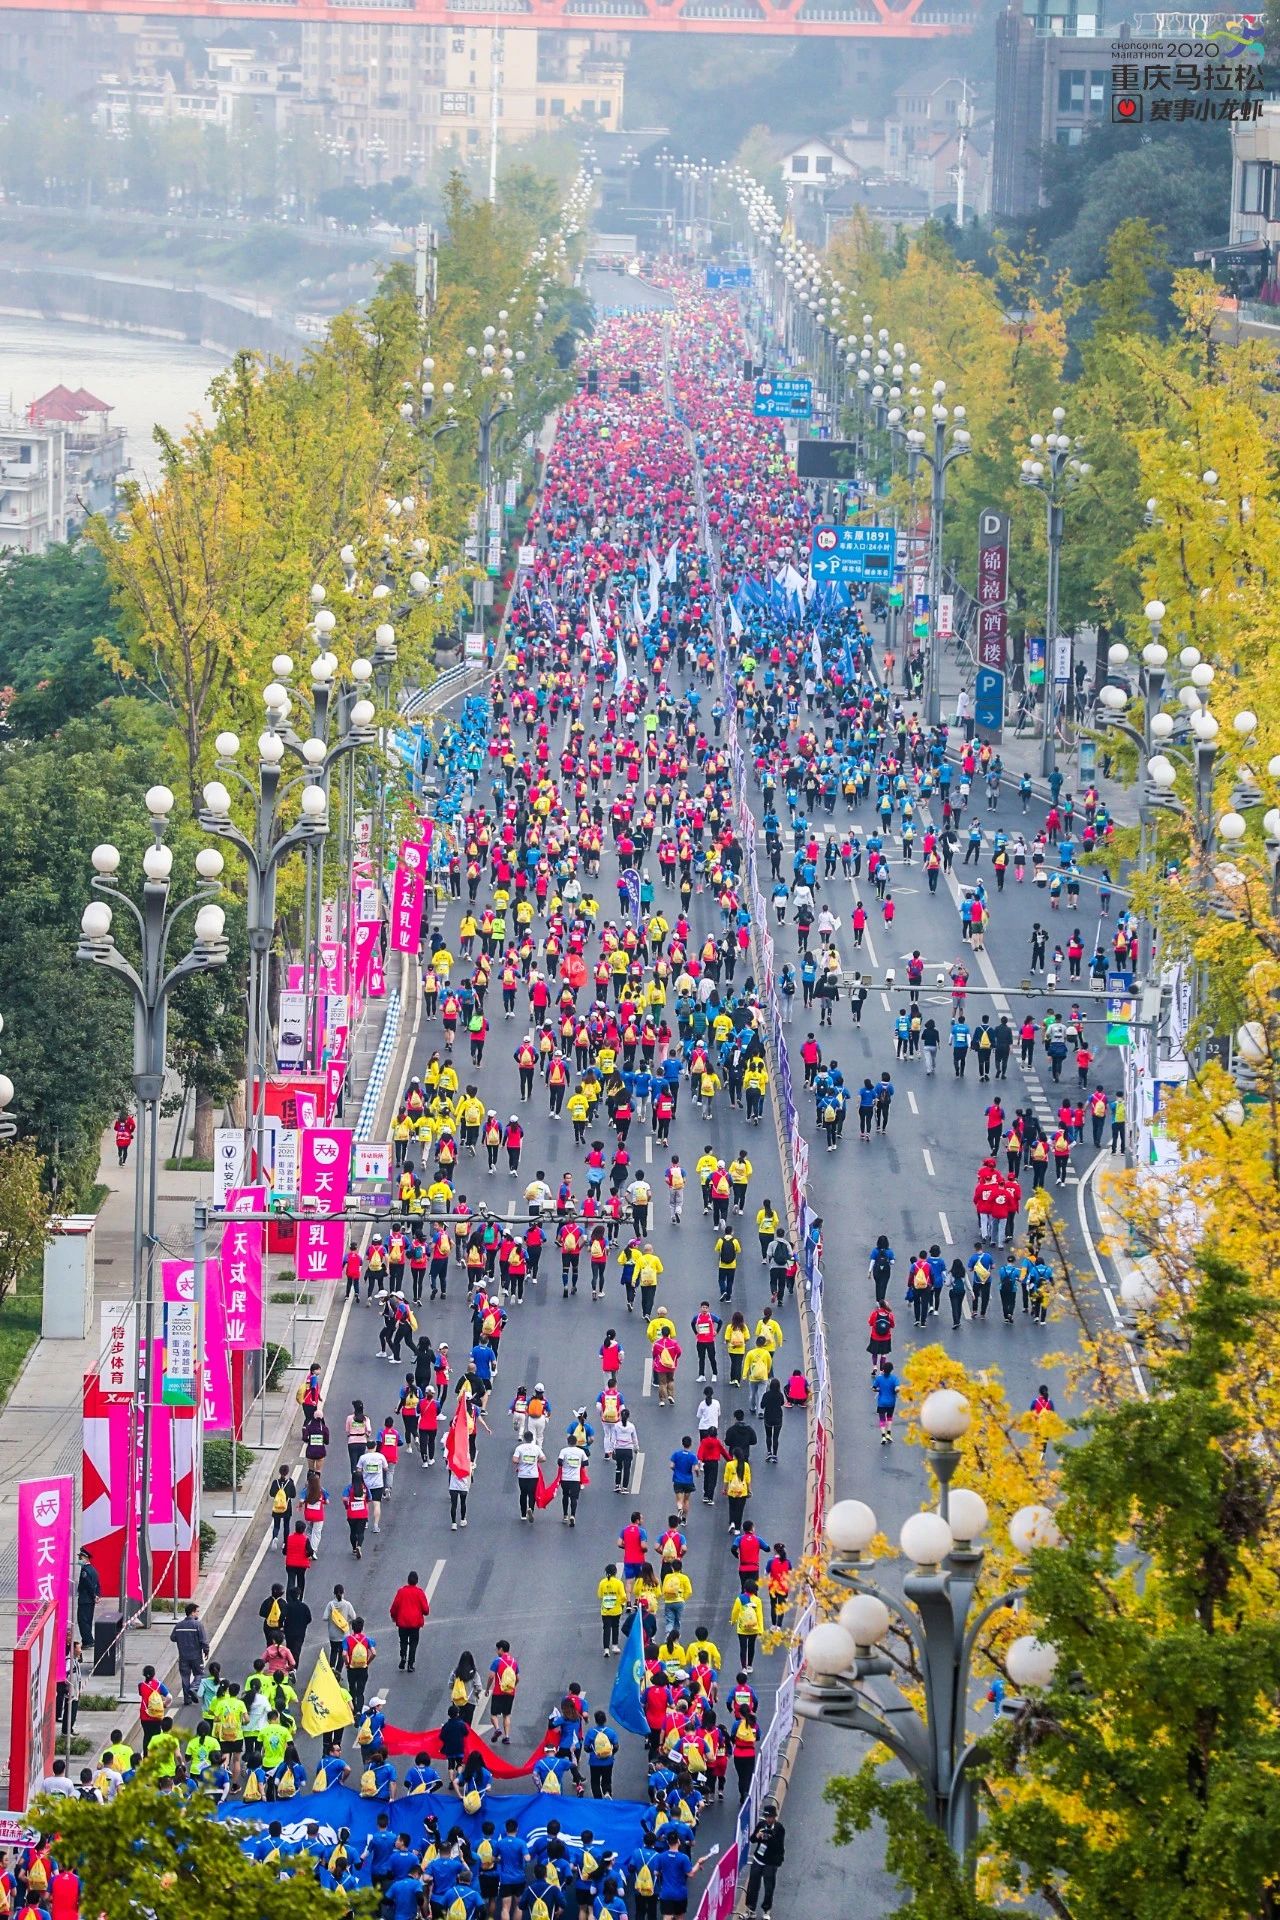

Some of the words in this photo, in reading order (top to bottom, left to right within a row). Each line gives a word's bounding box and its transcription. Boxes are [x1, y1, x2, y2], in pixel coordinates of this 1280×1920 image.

[984, 516, 1000, 534] D
[983, 677, 996, 693] P
[1206, 1044, 1220, 1054] 32
[315, 1144, 337, 1158] 天友
[110, 1326, 125, 1385] 特步体育
